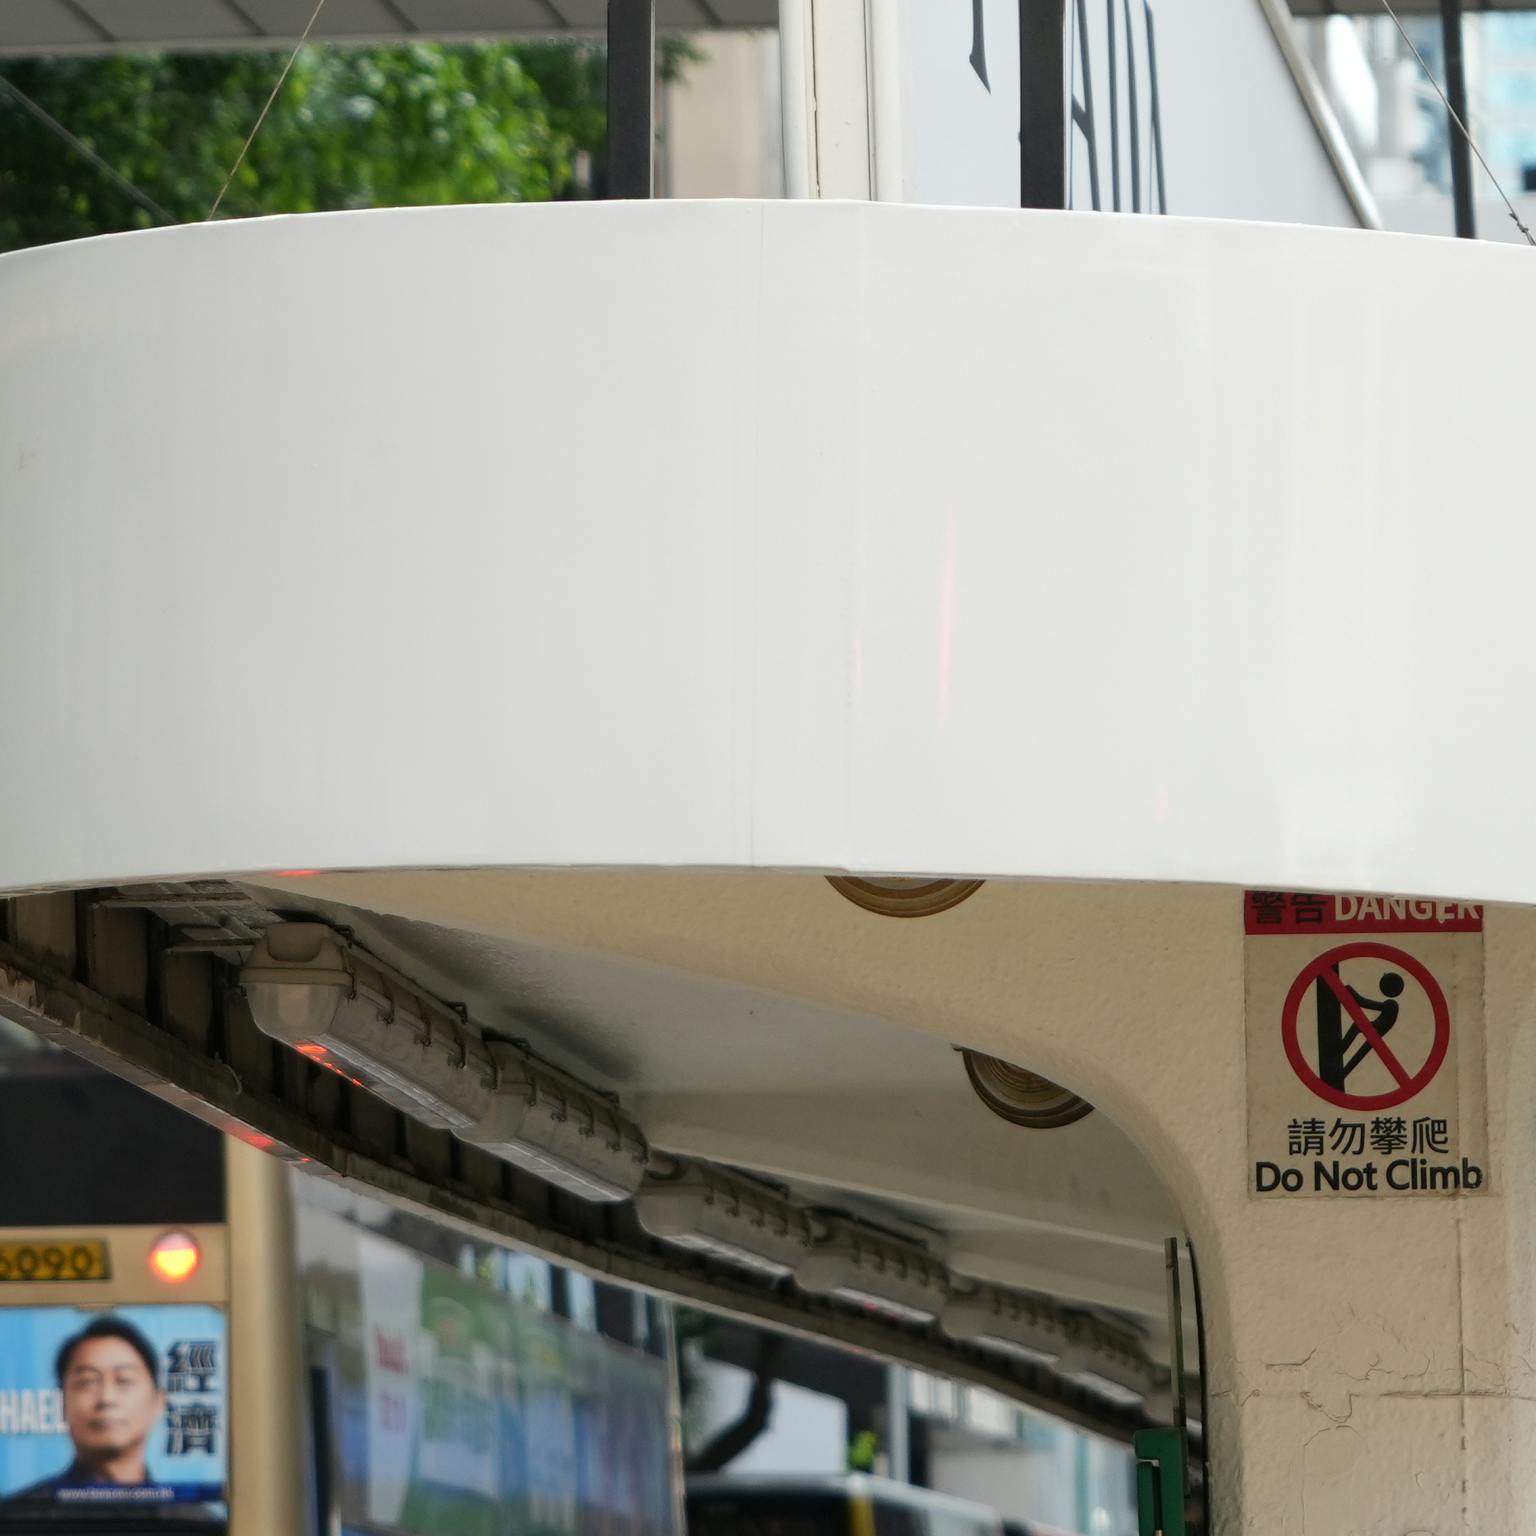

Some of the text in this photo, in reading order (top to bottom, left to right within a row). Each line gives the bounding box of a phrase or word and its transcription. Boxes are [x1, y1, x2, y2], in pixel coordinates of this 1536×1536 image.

[1288, 1117, 1449, 1156] 請勿攀爬
[1256, 1157, 1483, 1192] Do Not Climb
